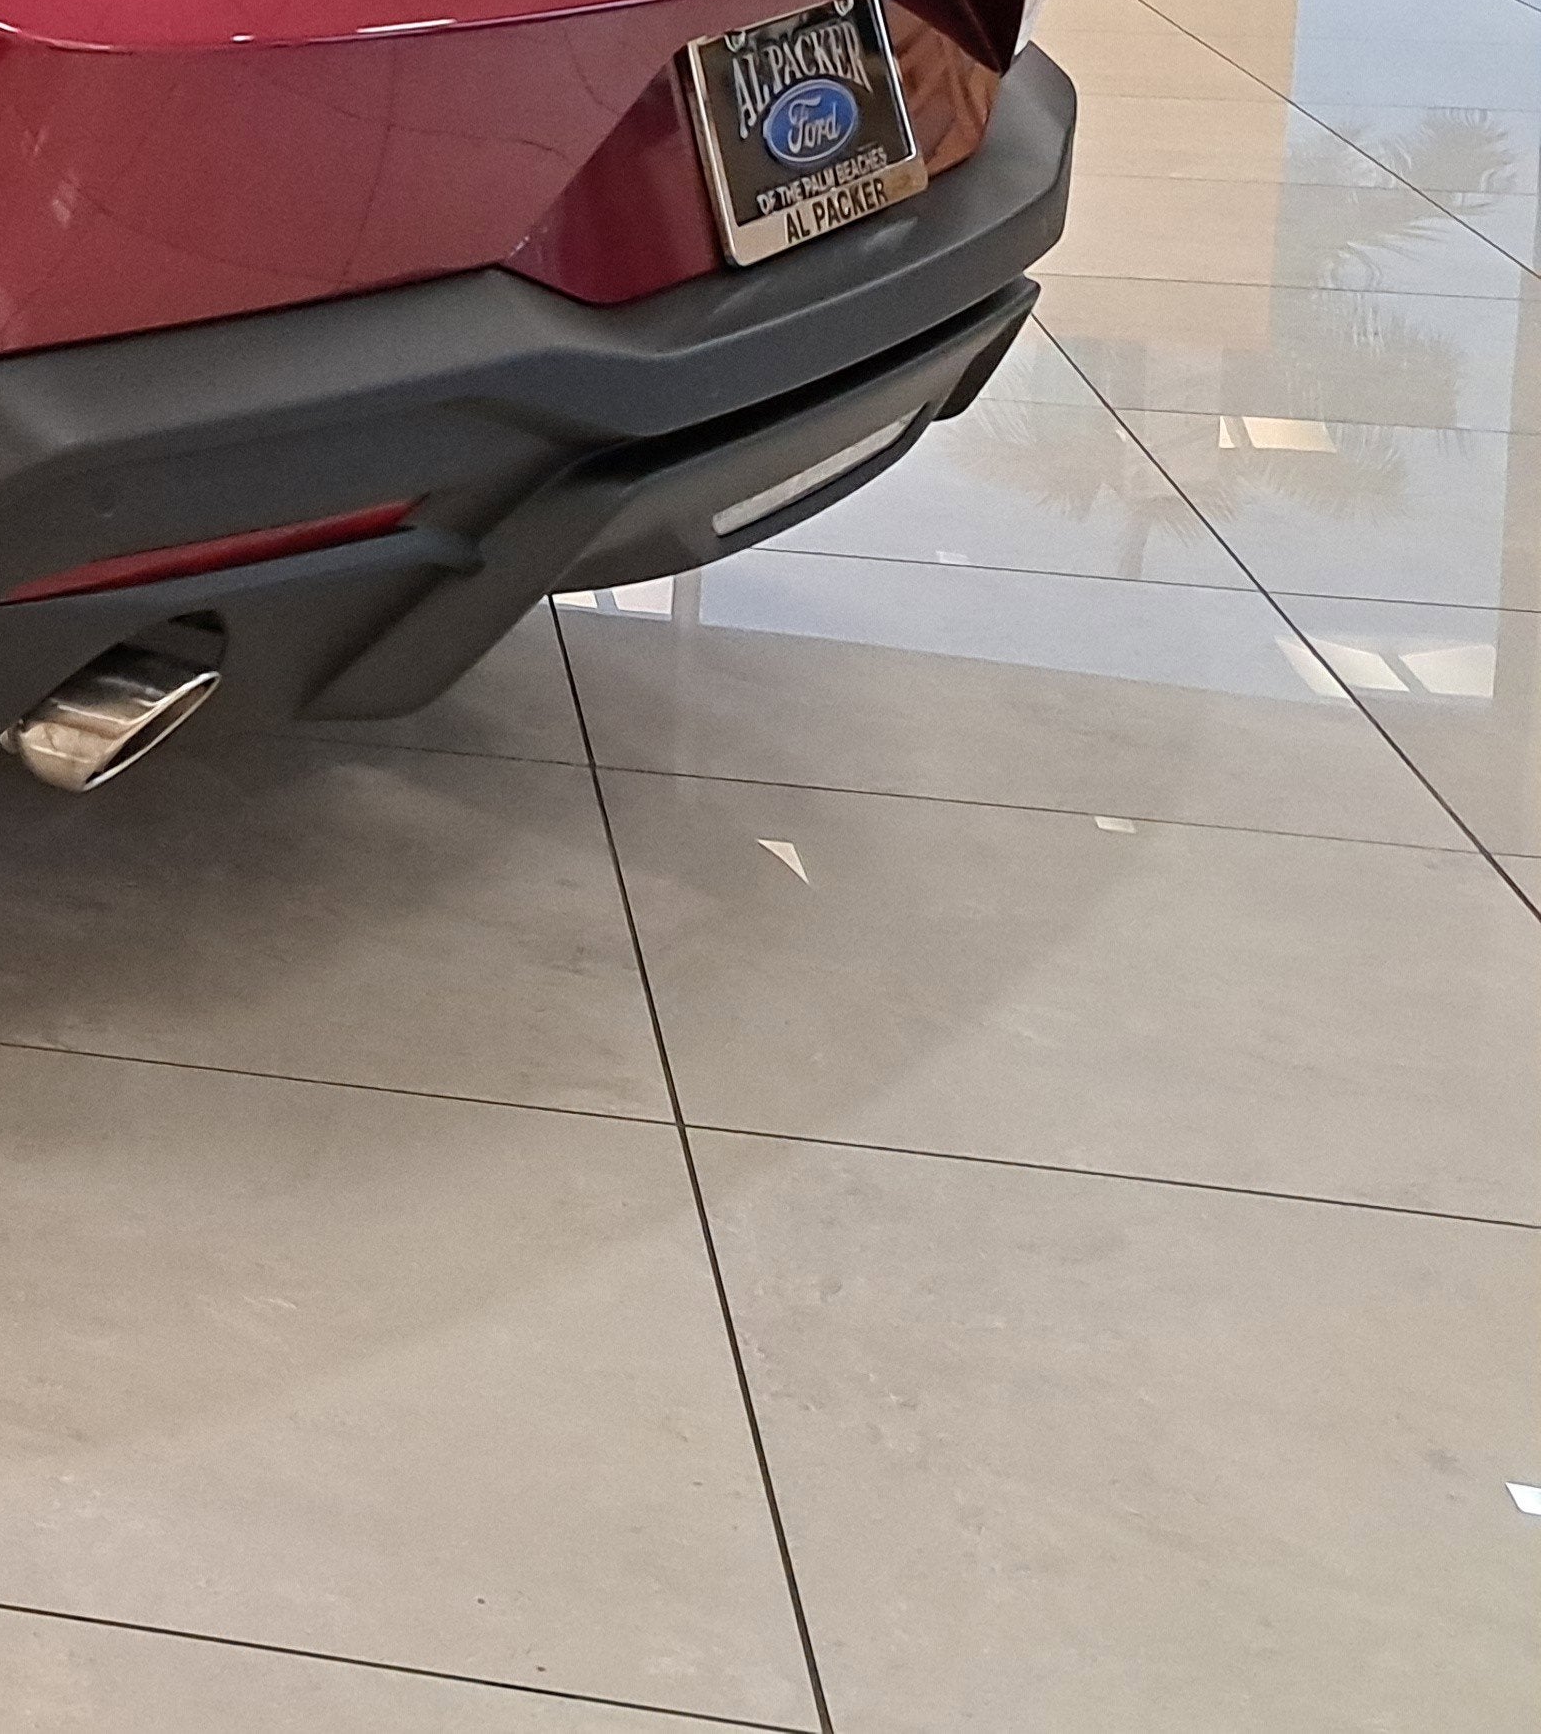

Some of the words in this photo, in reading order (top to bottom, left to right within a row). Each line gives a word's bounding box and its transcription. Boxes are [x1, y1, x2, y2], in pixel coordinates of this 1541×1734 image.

[732, 55, 769, 140] AL
[767, 22, 872, 95] PACKER
[787, 97, 842, 155] Ford
[776, 174, 804, 206] THE
[800, 161, 837, 198] PALM
[785, 210, 810, 244] AL
[812, 178, 888, 232] PACKER
